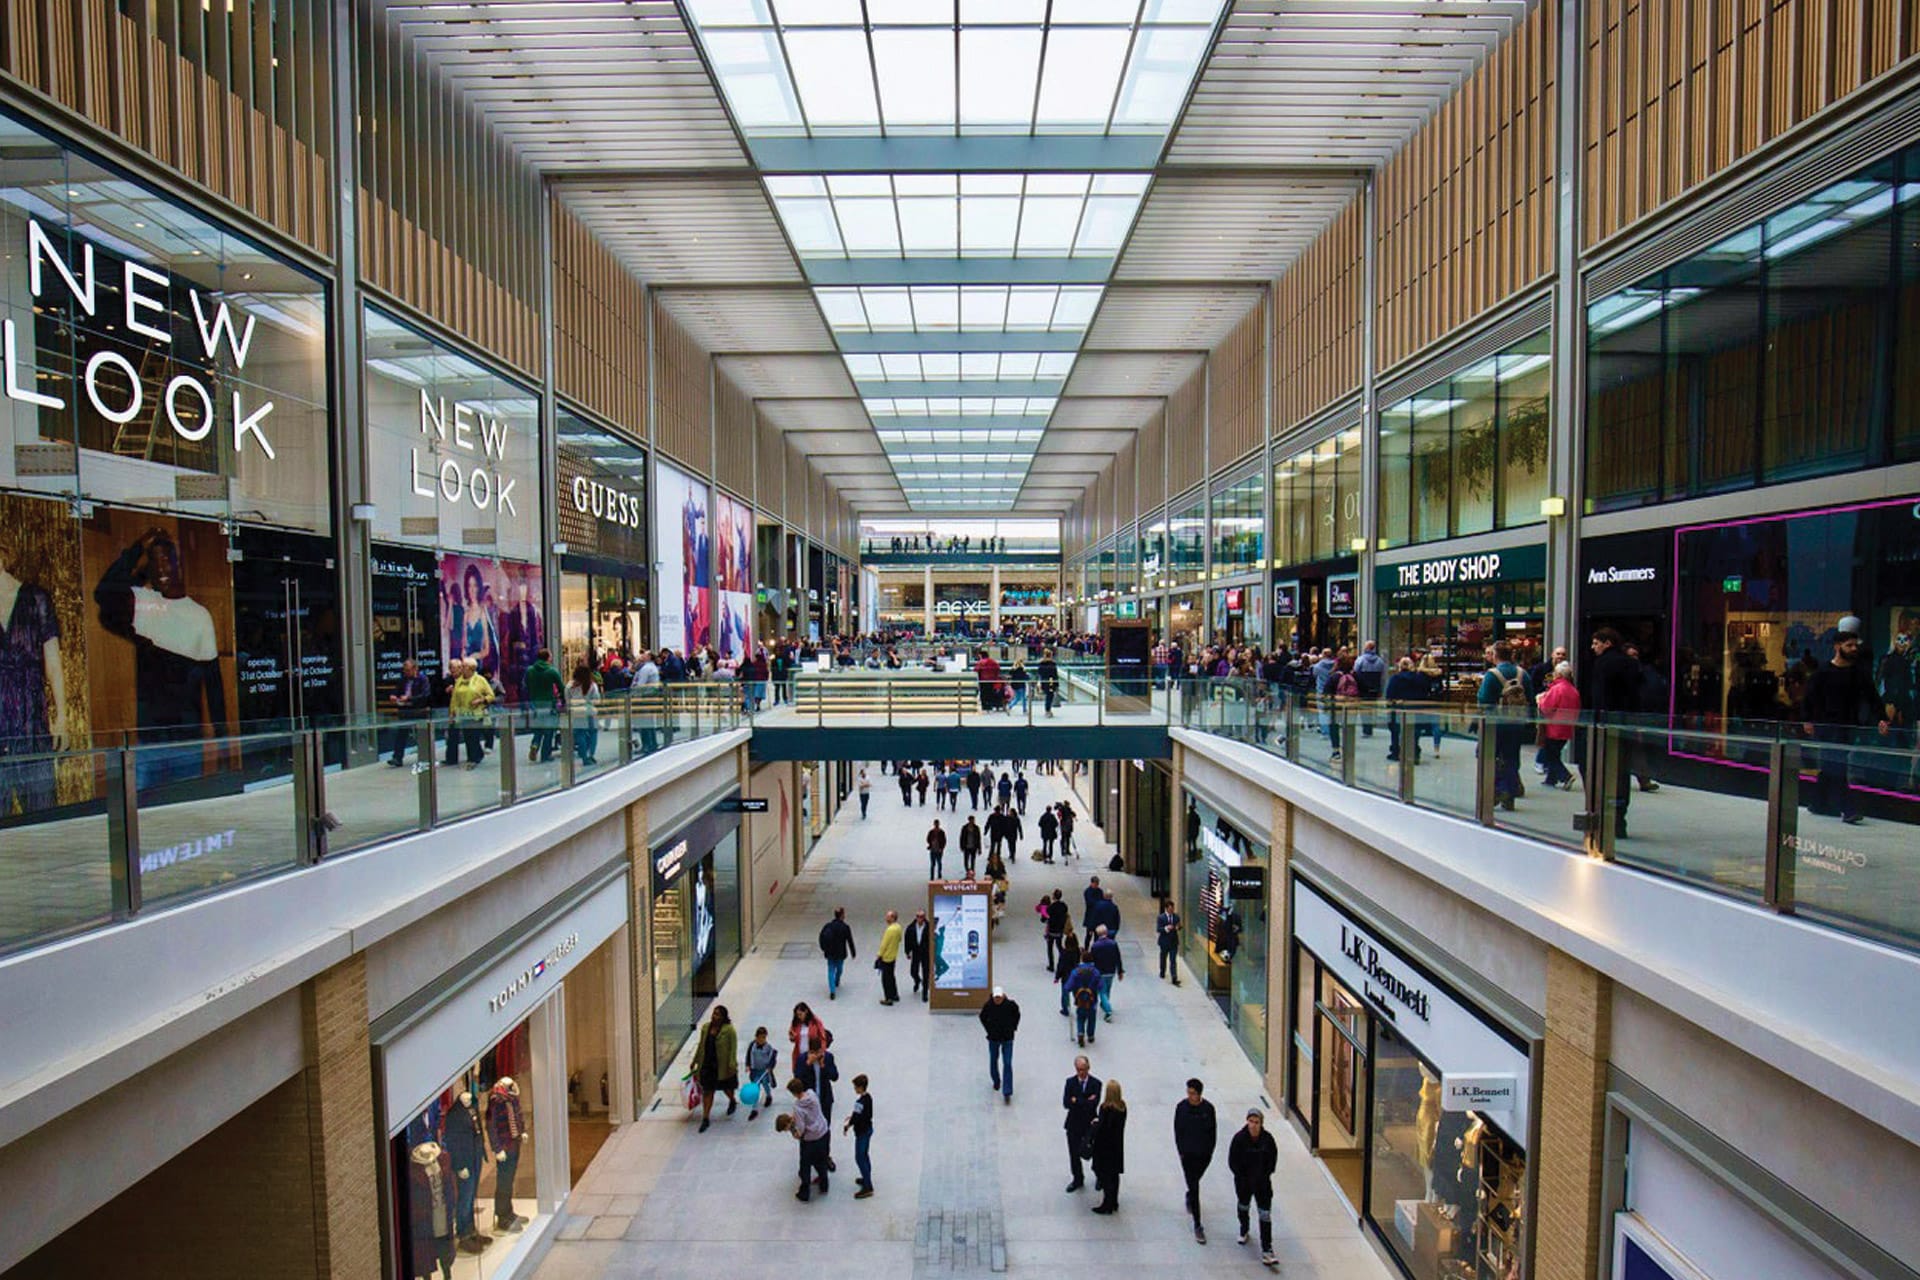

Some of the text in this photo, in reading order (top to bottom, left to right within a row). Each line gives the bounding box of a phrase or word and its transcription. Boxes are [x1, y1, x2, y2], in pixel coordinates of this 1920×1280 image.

[28, 219, 255, 369] NEW
[4, 318, 275, 460] LOOK
[420, 388, 508, 461] NEW
[411, 446, 517, 517] LOOK
[573, 476, 639, 529] GUESS
[1398, 564, 1420, 587] THE
[1423, 558, 1458, 584] BODY
[1588, 566, 1655, 584] Ann Summers
[248, 658, 276, 668] opening
[302, 656, 328, 664] opening
[309, 667, 334, 675] October
[240, 670, 283, 680] 31st October
[489, 966, 535, 1014] TOMMY
[1451, 1086, 1510, 1097] L.K.Bennett
